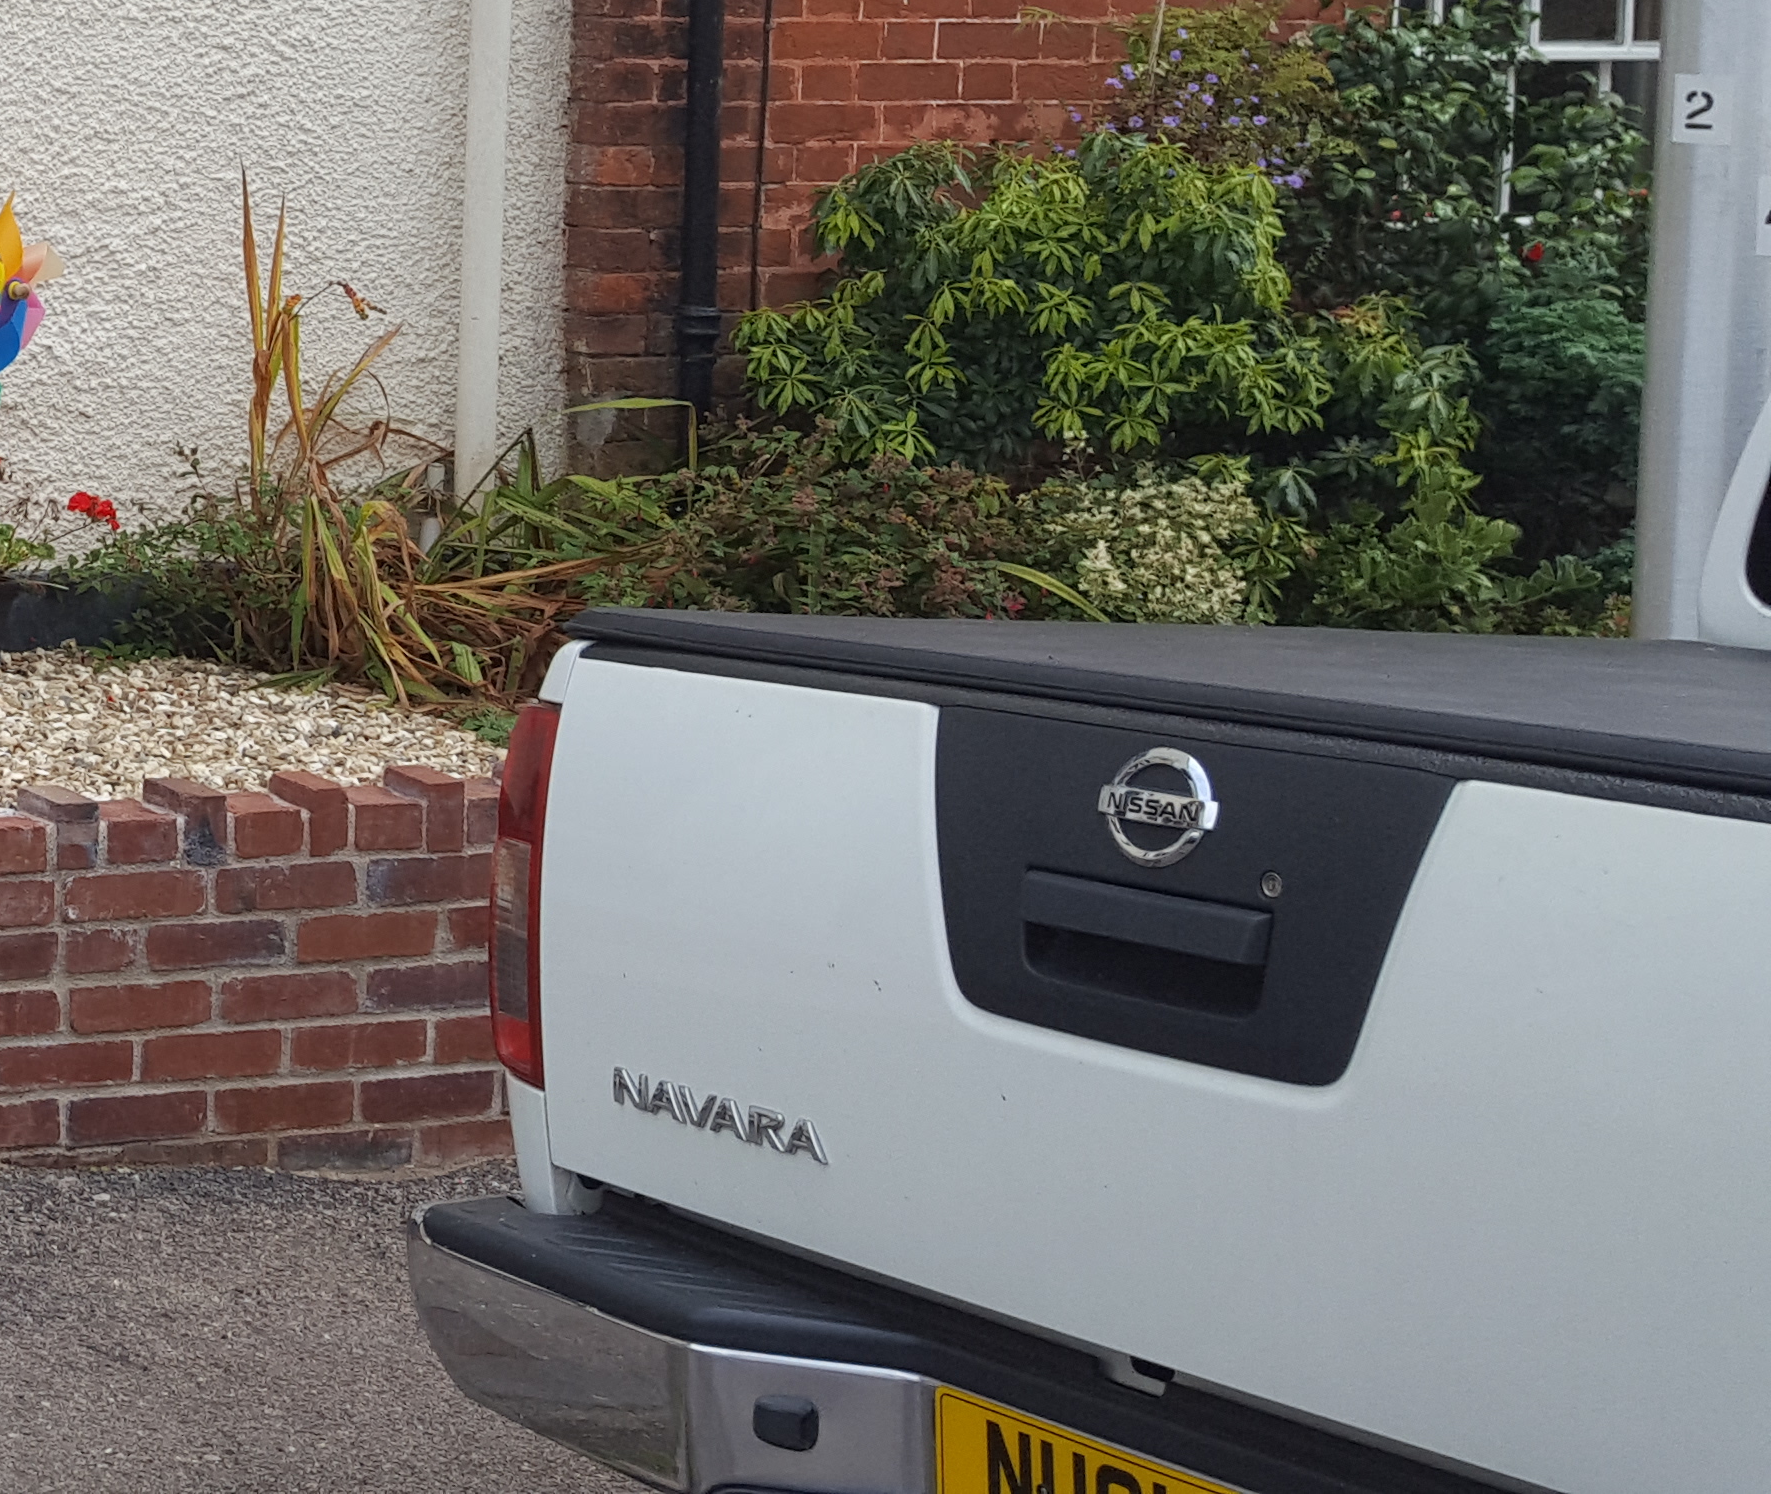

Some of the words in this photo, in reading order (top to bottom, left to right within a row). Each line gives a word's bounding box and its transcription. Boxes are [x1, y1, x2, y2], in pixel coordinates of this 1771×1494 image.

[1684, 90, 1714, 130] 2
[1107, 791, 1199, 822] NISSAN
[613, 1066, 829, 1166] NAVARA
